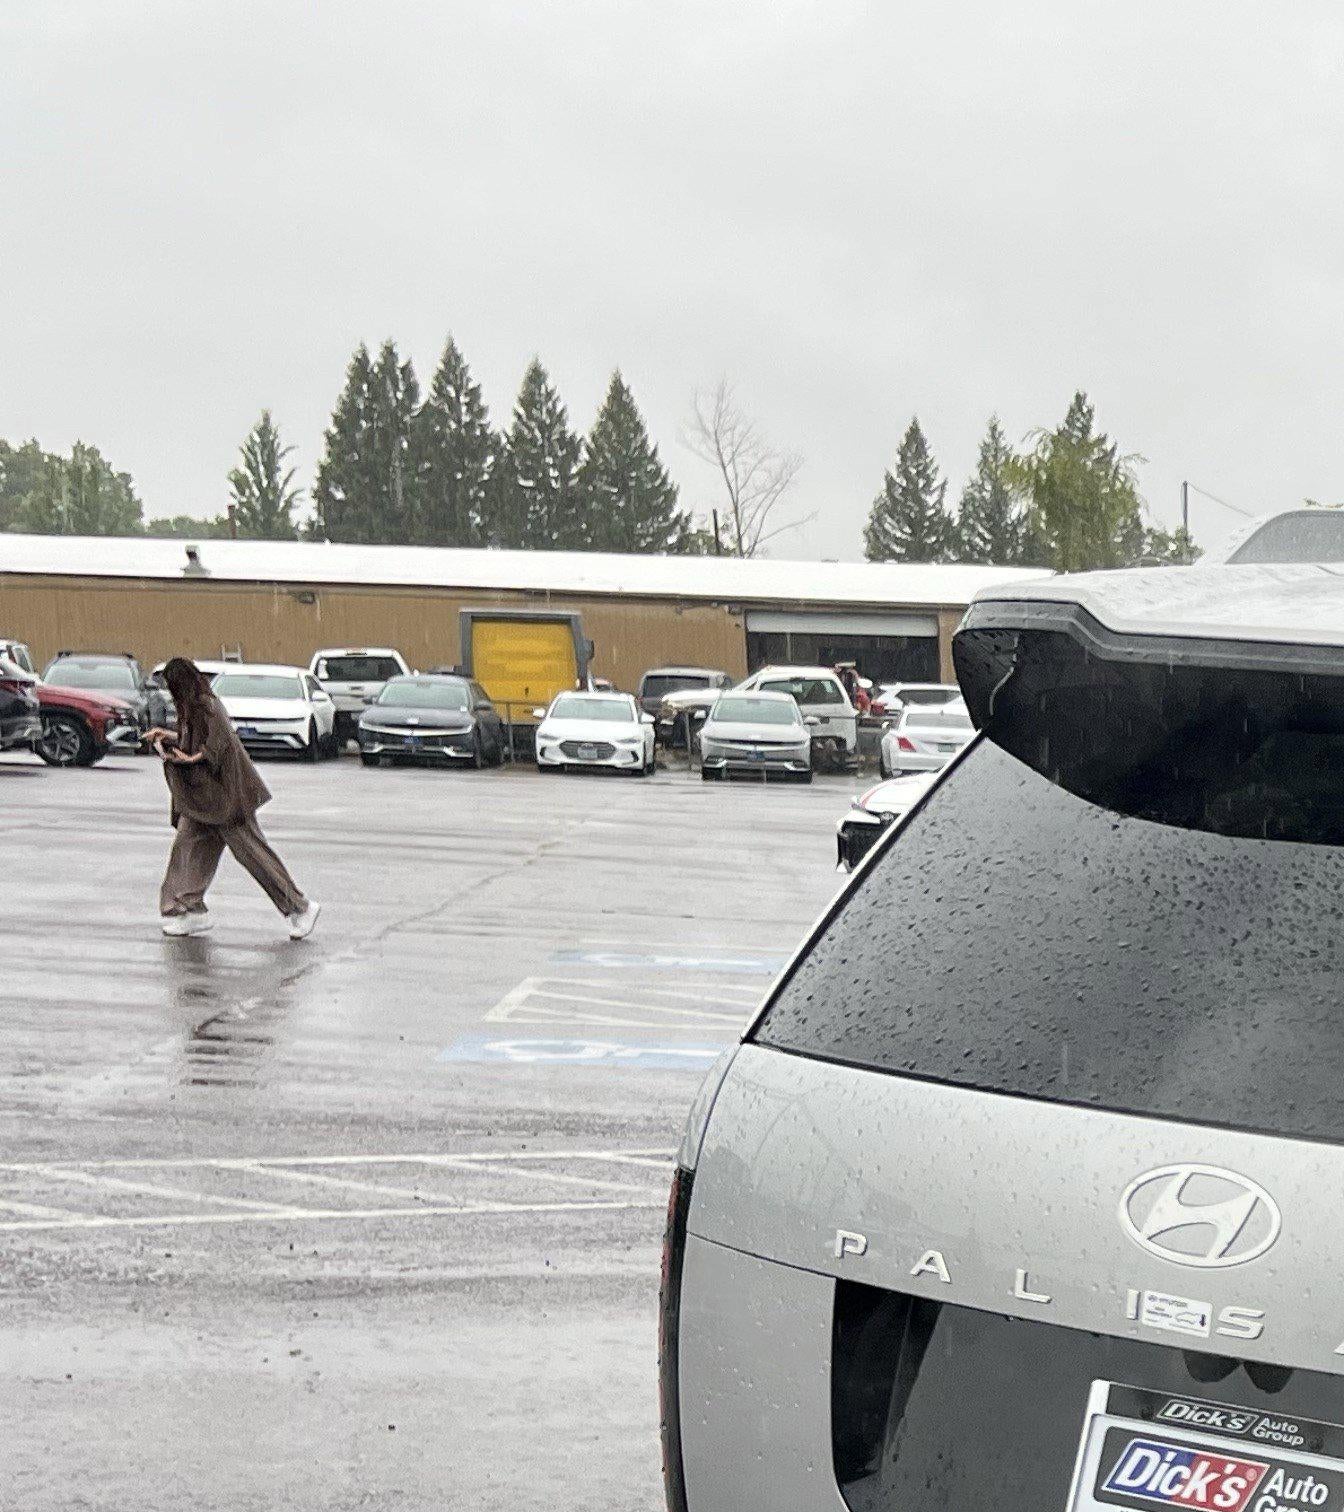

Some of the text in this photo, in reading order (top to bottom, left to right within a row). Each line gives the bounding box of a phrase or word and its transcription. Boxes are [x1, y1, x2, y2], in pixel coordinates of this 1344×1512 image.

[1163, 1402, 1299, 1434] Dick's Auto
[1251, 1425, 1305, 1447] Group
[1114, 1446, 1330, 1510] Dick's Auto
